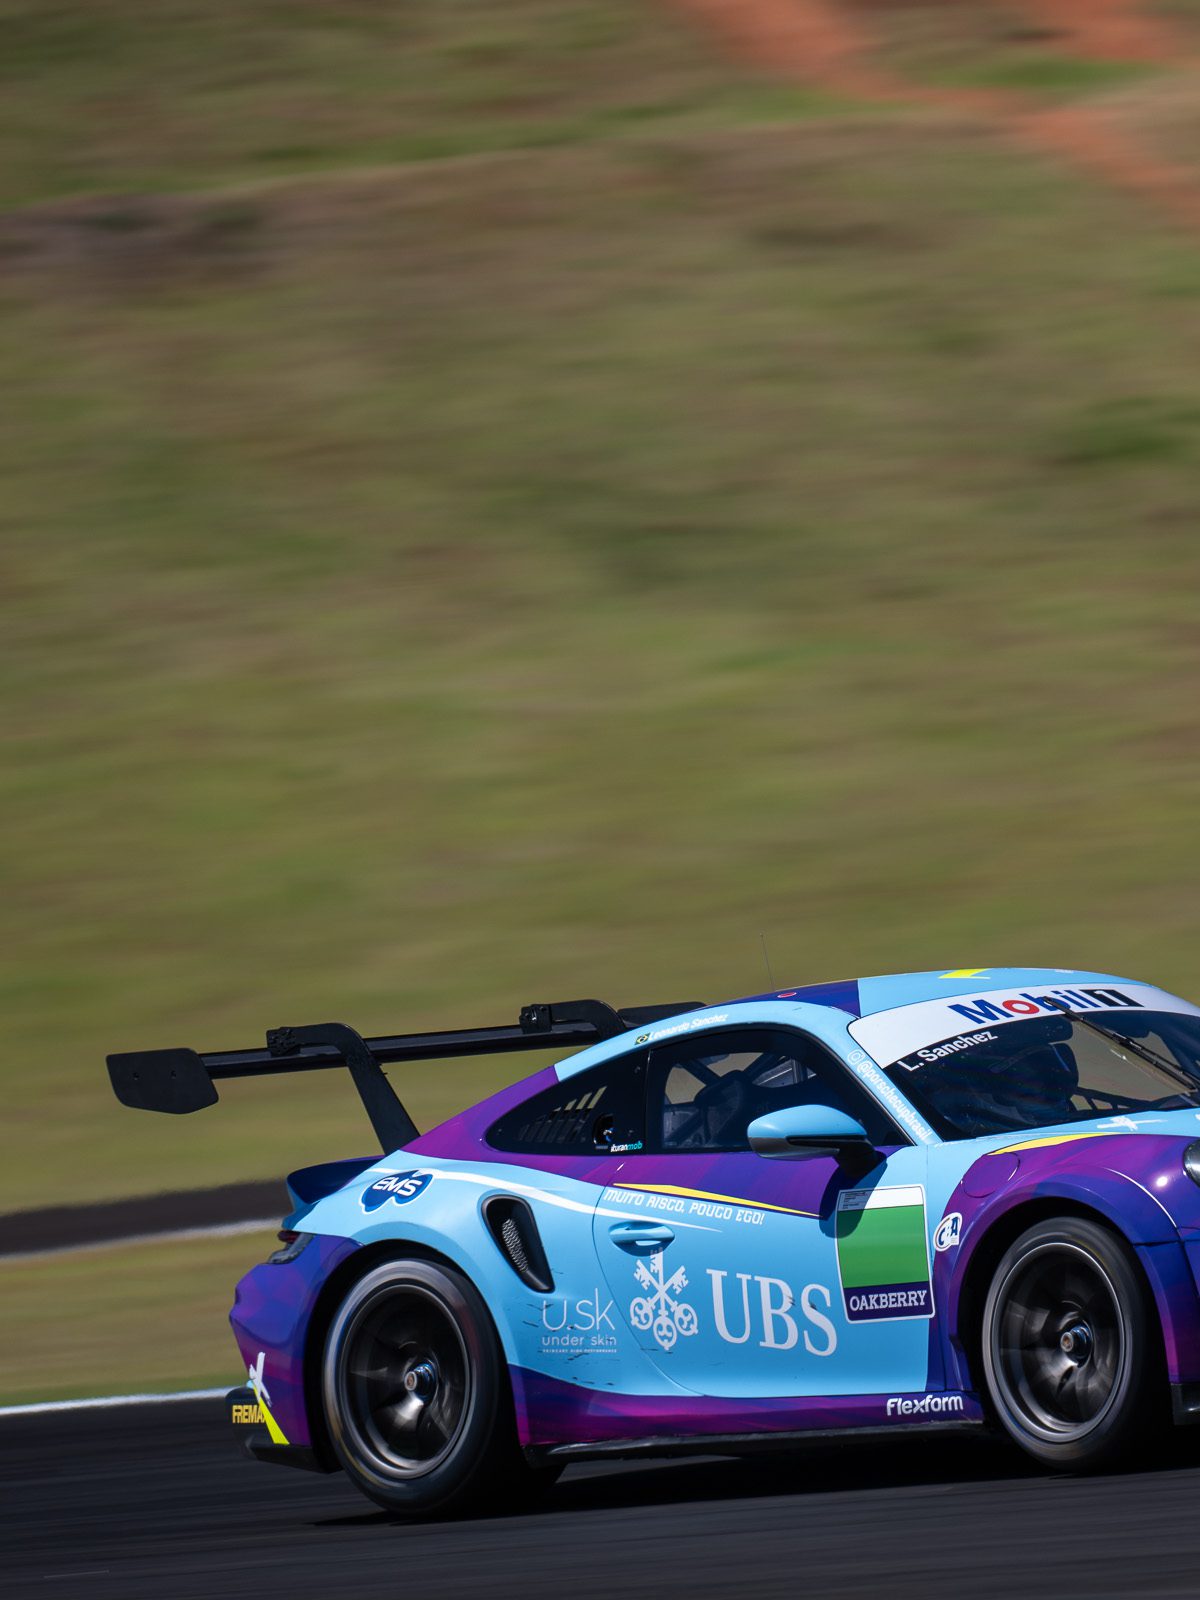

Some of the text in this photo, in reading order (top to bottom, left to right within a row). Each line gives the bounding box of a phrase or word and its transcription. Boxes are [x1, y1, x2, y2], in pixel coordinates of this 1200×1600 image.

[948, 989, 1102, 1025] Mobil
[896, 1030, 999, 1072] L. Sanchez
[371, 1175, 425, 1198] EMS
[603, 1189, 644, 1206] MUITO
[688, 1202, 733, 1220] POUCO
[735, 1210, 766, 1226] EGO!
[705, 1268, 838, 1357] UBS
[849, 1290, 927, 1312] OAKBERRY
[542, 1334, 617, 1346] under skin
[232, 1404, 266, 1424] FREMA
[886, 1394, 964, 1417] Flexform
